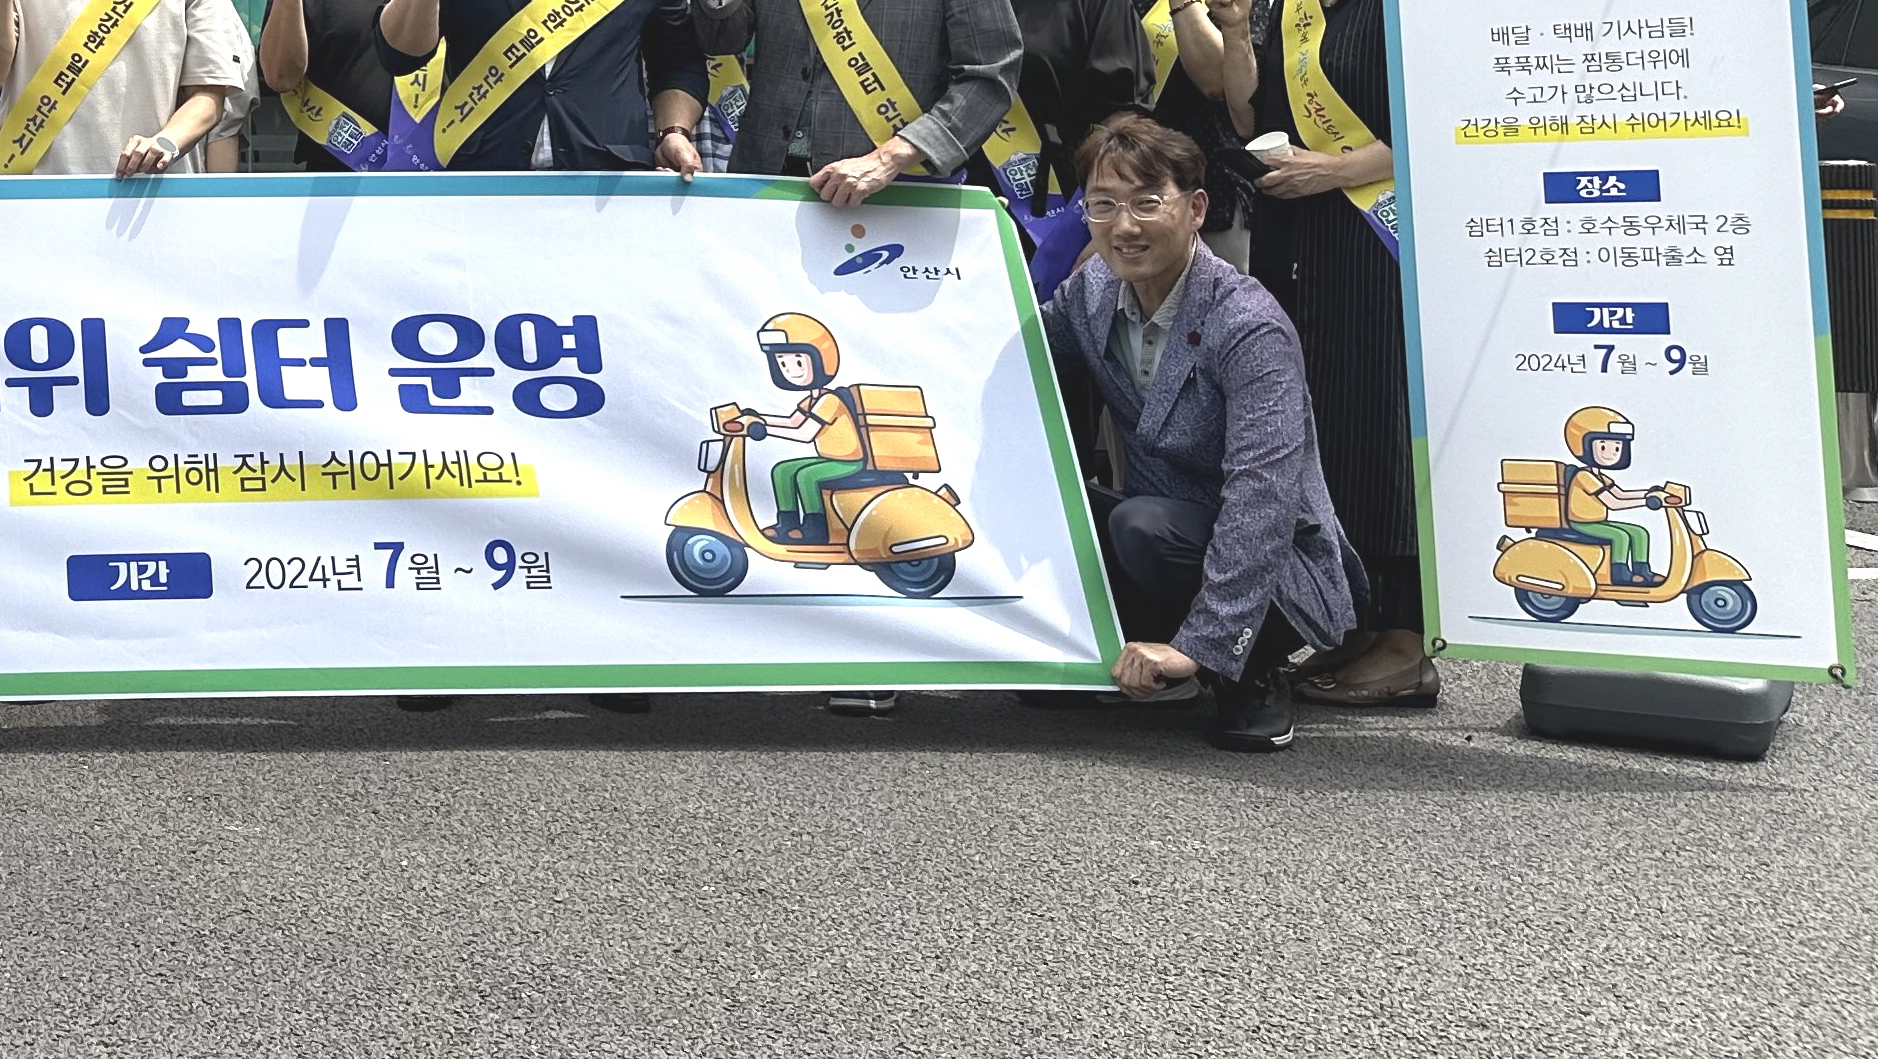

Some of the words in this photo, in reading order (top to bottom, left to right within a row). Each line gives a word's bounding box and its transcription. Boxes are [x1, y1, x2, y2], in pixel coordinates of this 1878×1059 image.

[1490, 24, 1532, 47] 배달
[1552, 21, 1594, 44] 택배
[1601, 16, 1695, 41] 기사님들!
[503, 28, 545, 69] 일터
[1492, 53, 1576, 77] 푹푹찌는
[1581, 47, 1690, 73] 찜통더위에
[53, 52, 90, 96] 일터
[847, 51, 886, 95] 일터
[442, 65, 505, 134] 안산시!
[1505, 84, 1568, 107] 수고가
[1574, 79, 1688, 105] 많으십니다.
[4, 94, 58, 169] 안산시!
[1460, 116, 1522, 139] 건강을
[1527, 114, 1569, 137] 위해
[1575, 112, 1618, 135] 잠시
[1625, 108, 1742, 133] 쉬어가세요!
[1575, 175, 1627, 198] 장소
[1464, 216, 1559, 238] 쉼터1호점
[1577, 214, 1709, 237] 호수동우체국
[1715, 213, 1752, 236] 2층
[1483, 246, 1579, 268] 쉼터2호점
[1597, 245, 1708, 268] 이동파출소
[1713, 245, 1736, 267] 옆
[899, 265, 962, 281] 안산시
[1585, 306, 1635, 330] 기간
[138, 316, 358, 417] 쉼터
[387, 312, 606, 420] 운영
[1514, 353, 1587, 374] 2024년
[1593, 344, 1637, 375] 7월
[1664, 344, 1709, 376] 9월
[22, 454, 134, 497] 건강을
[146, 452, 220, 494] 위해
[231, 450, 306, 493] 잠시
[320, 449, 522, 491] 쉬어가세요!
[108, 559, 171, 594] 기간
[243, 554, 364, 592] 2024년
[373, 541, 442, 591] 7월
[484, 539, 553, 591] 9월
